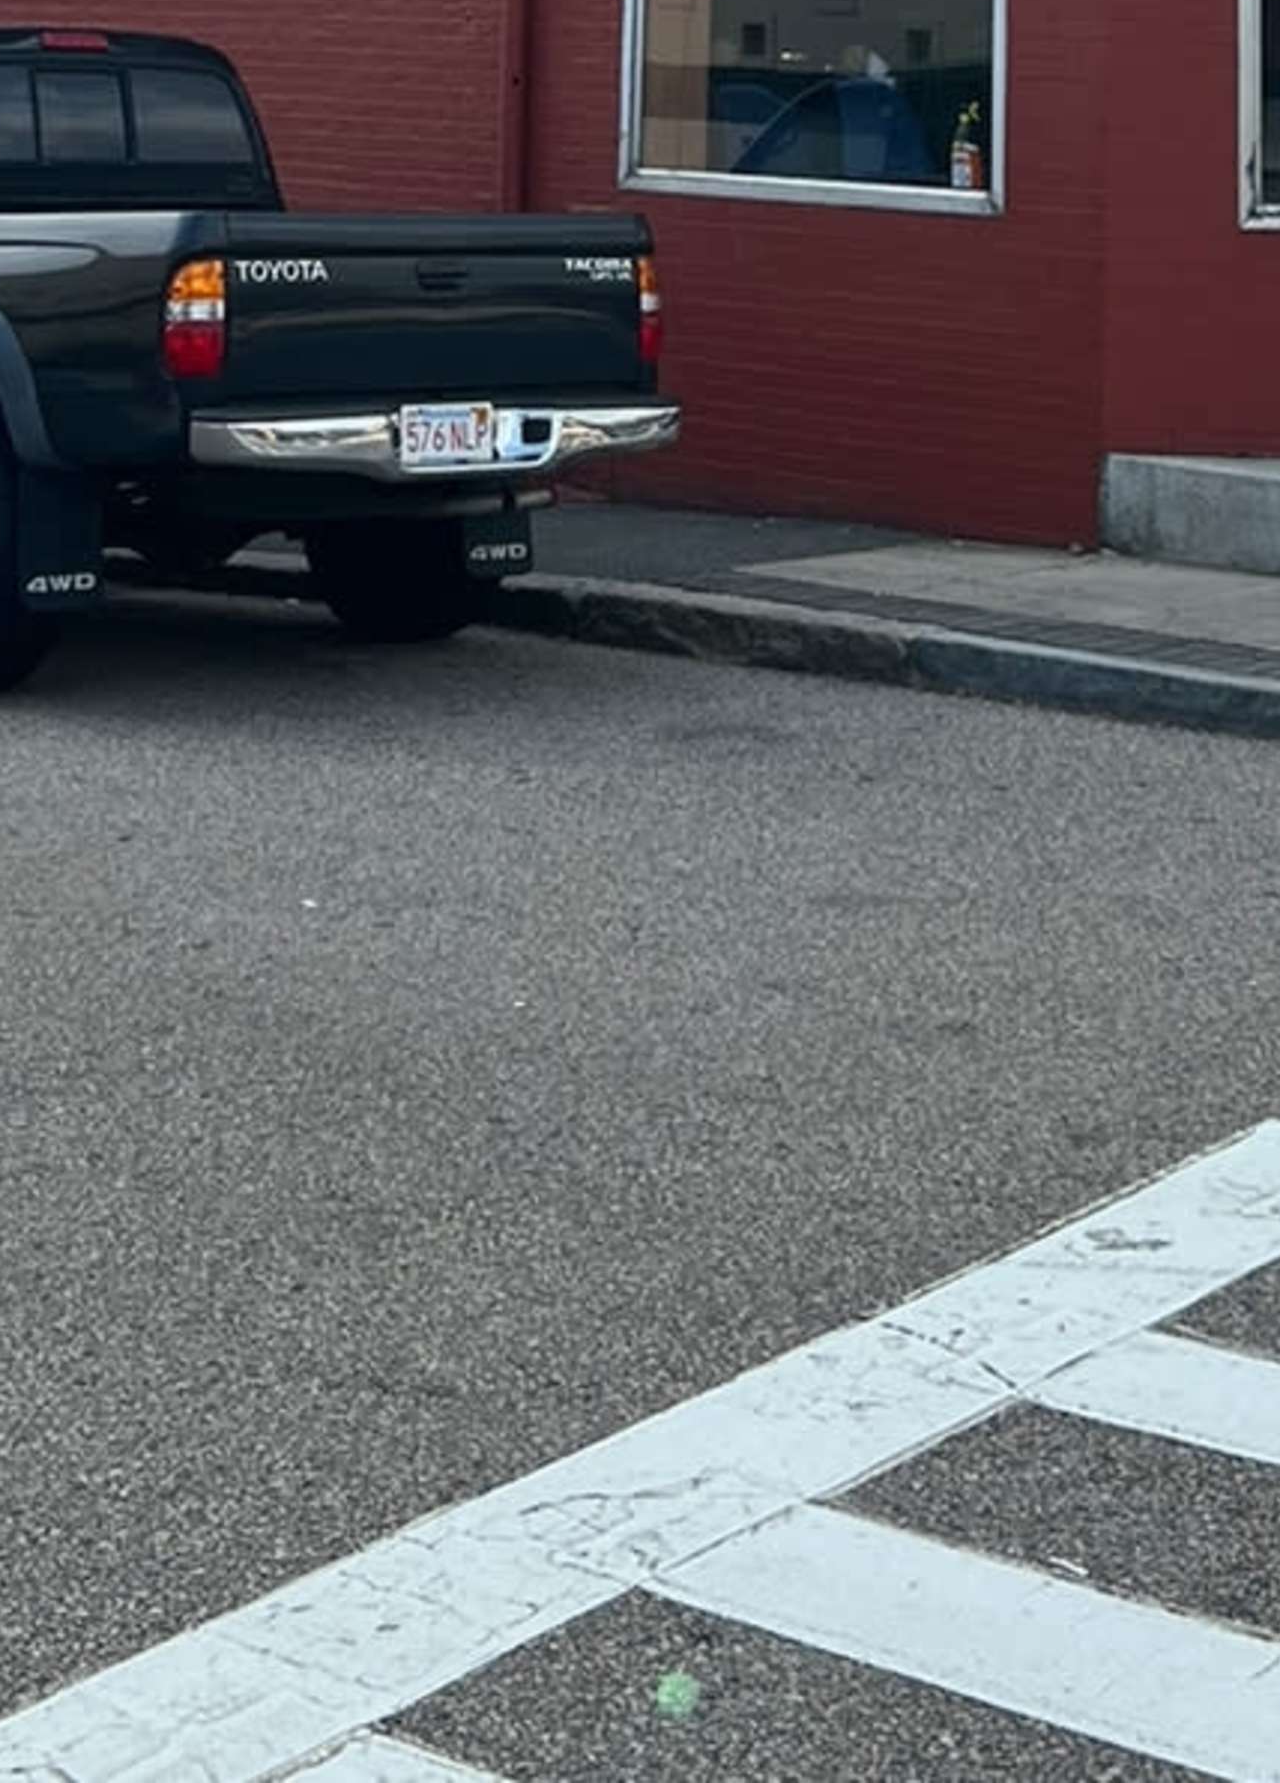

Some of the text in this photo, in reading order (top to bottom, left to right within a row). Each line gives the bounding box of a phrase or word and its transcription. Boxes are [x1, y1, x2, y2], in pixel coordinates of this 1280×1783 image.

[234, 260, 330, 283] TOYOTA
[564, 256, 633, 272] TACOMA
[406, 419, 489, 453] 576 NLP
[468, 542, 528, 561] 4WD
[25, 572, 97, 594] 4WD
